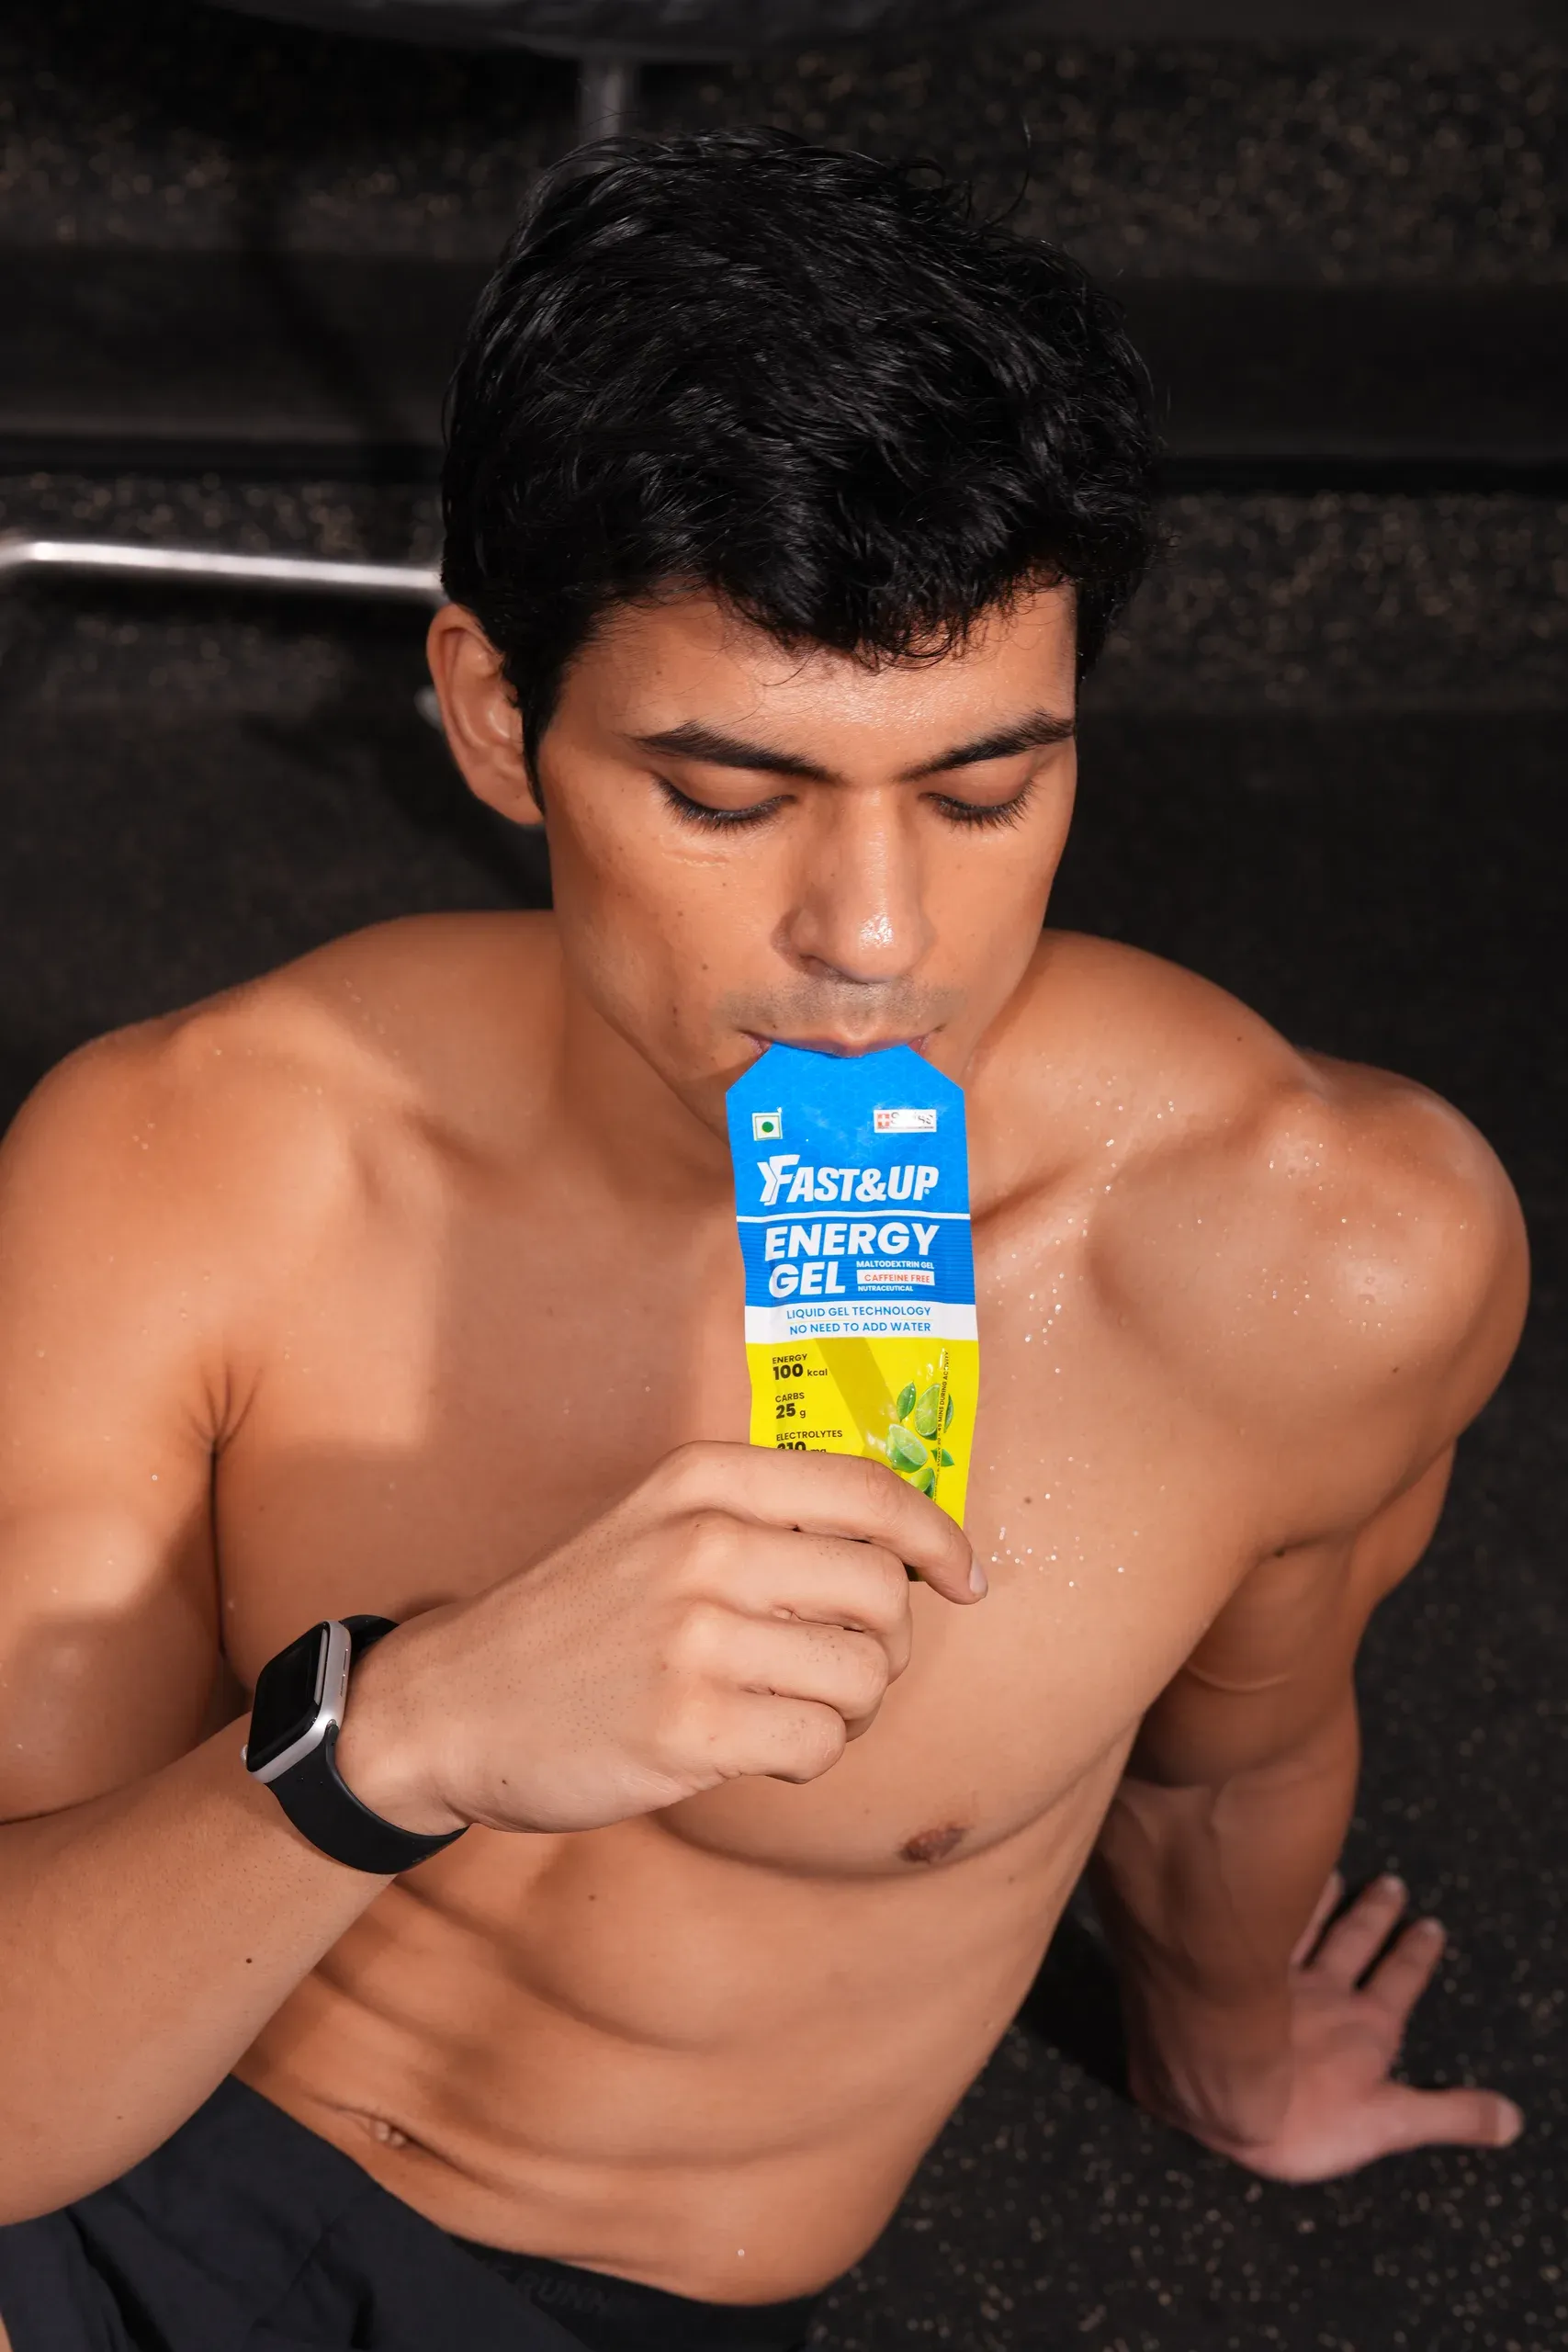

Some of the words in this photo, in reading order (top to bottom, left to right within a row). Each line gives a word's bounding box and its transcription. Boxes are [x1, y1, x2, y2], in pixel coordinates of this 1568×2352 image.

[757, 1154, 940, 1206] FAST&UP
[765, 1222, 940, 1261] ENERGY
[920, 1261, 934, 1270] GEL
[769, 1261, 846, 1298] GEL
[910, 1274, 931, 1283] FREE
[786, 1307, 826, 1319] LIQUID
[829, 1306, 849, 1317] GEL
[852, 1306, 931, 1316] TECHNOLOGY
[790, 1324, 807, 1335] NO
[810, 1322, 840, 1332] NEED
[843, 1322, 859, 1331] TO
[863, 1322, 887, 1331] ADD
[890, 1321, 931, 1332] WATER
[773, 1353, 808, 1364] ENERGY
[773, 1363, 804, 1380] 100
[774, 1392, 805, 1403] CARBS
[939, 1381, 948, 1406] DURING
[775, 1402, 796, 1419] 25
[799, 1409, 807, 1419] g
[776, 1430, 843, 1441] ELECTROLYTES
